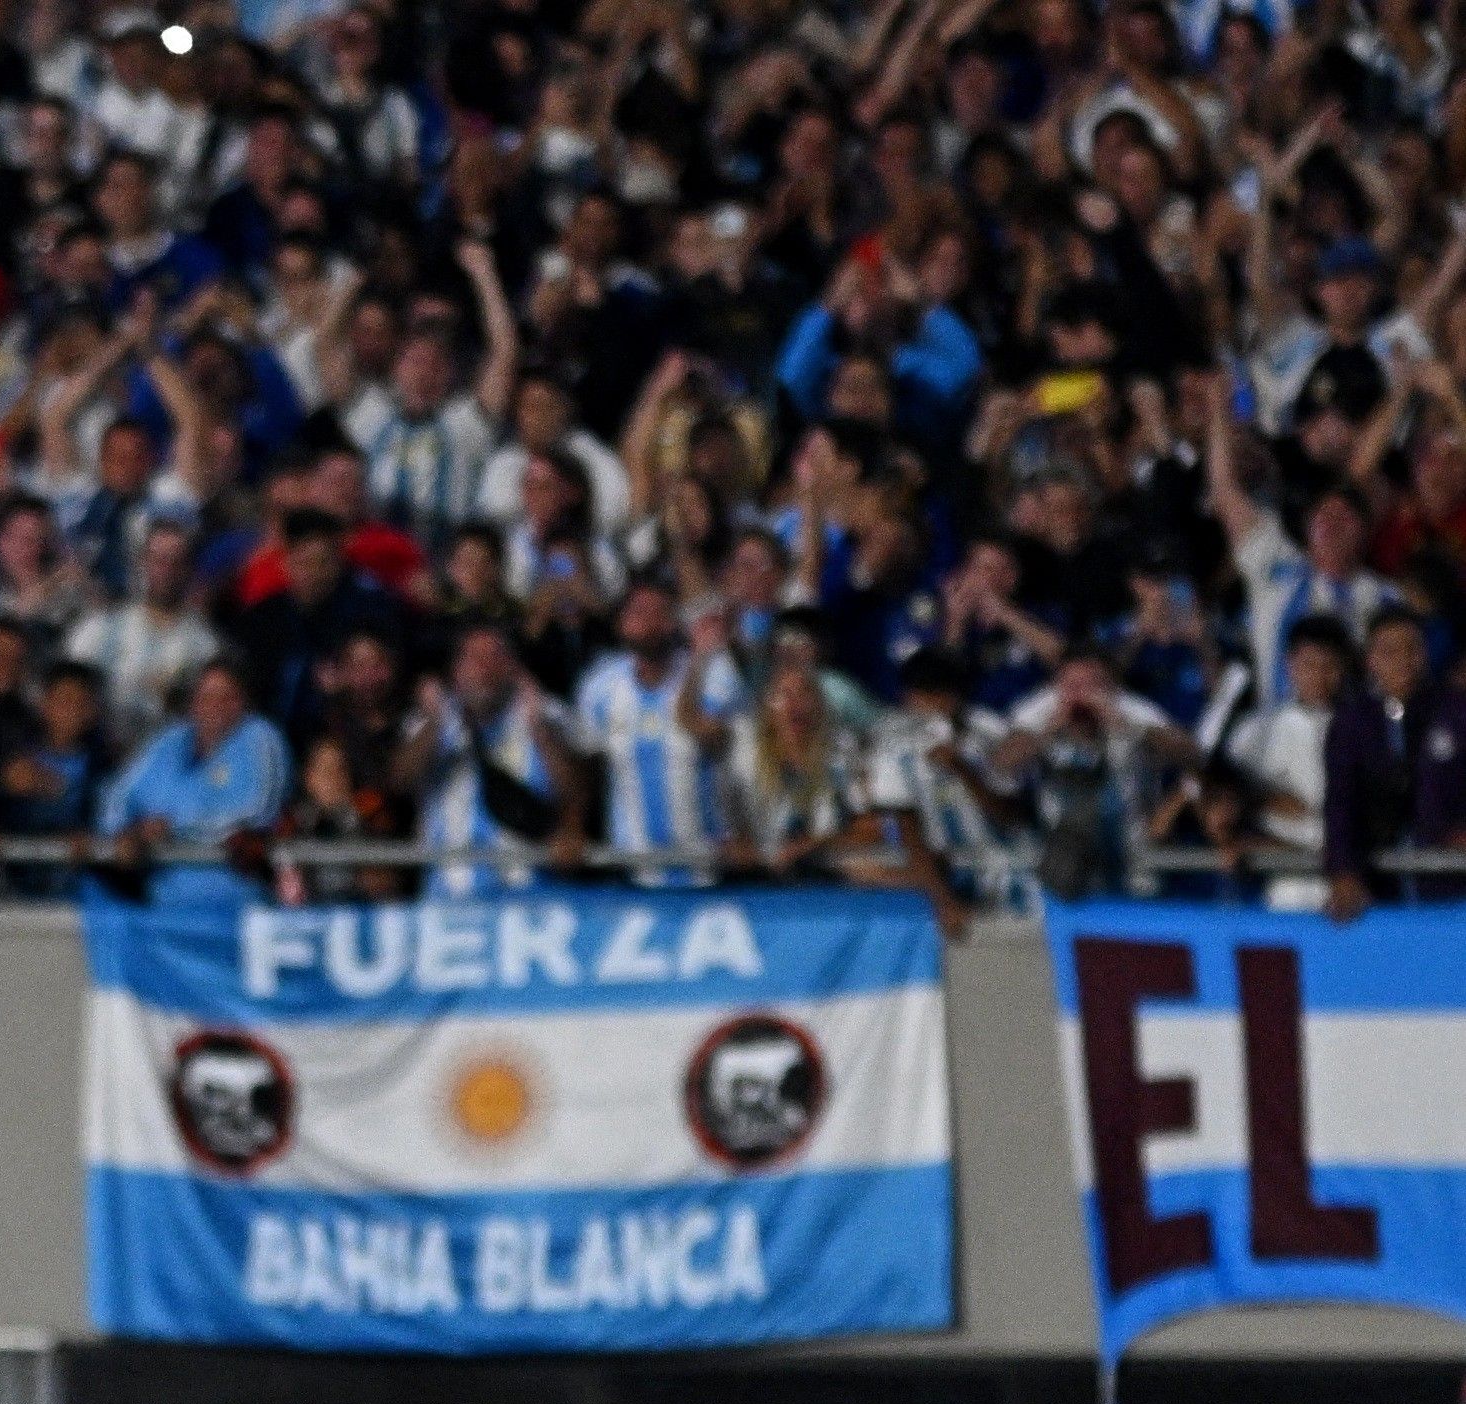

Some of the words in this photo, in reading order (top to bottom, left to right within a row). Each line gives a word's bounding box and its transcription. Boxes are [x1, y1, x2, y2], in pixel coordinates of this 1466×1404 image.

[241, 904, 765, 997] FUERZA
[1072, 936, 1382, 1296] EL
[244, 1214, 459, 1314] BAHIA
[472, 1204, 768, 1313] BLANCA
